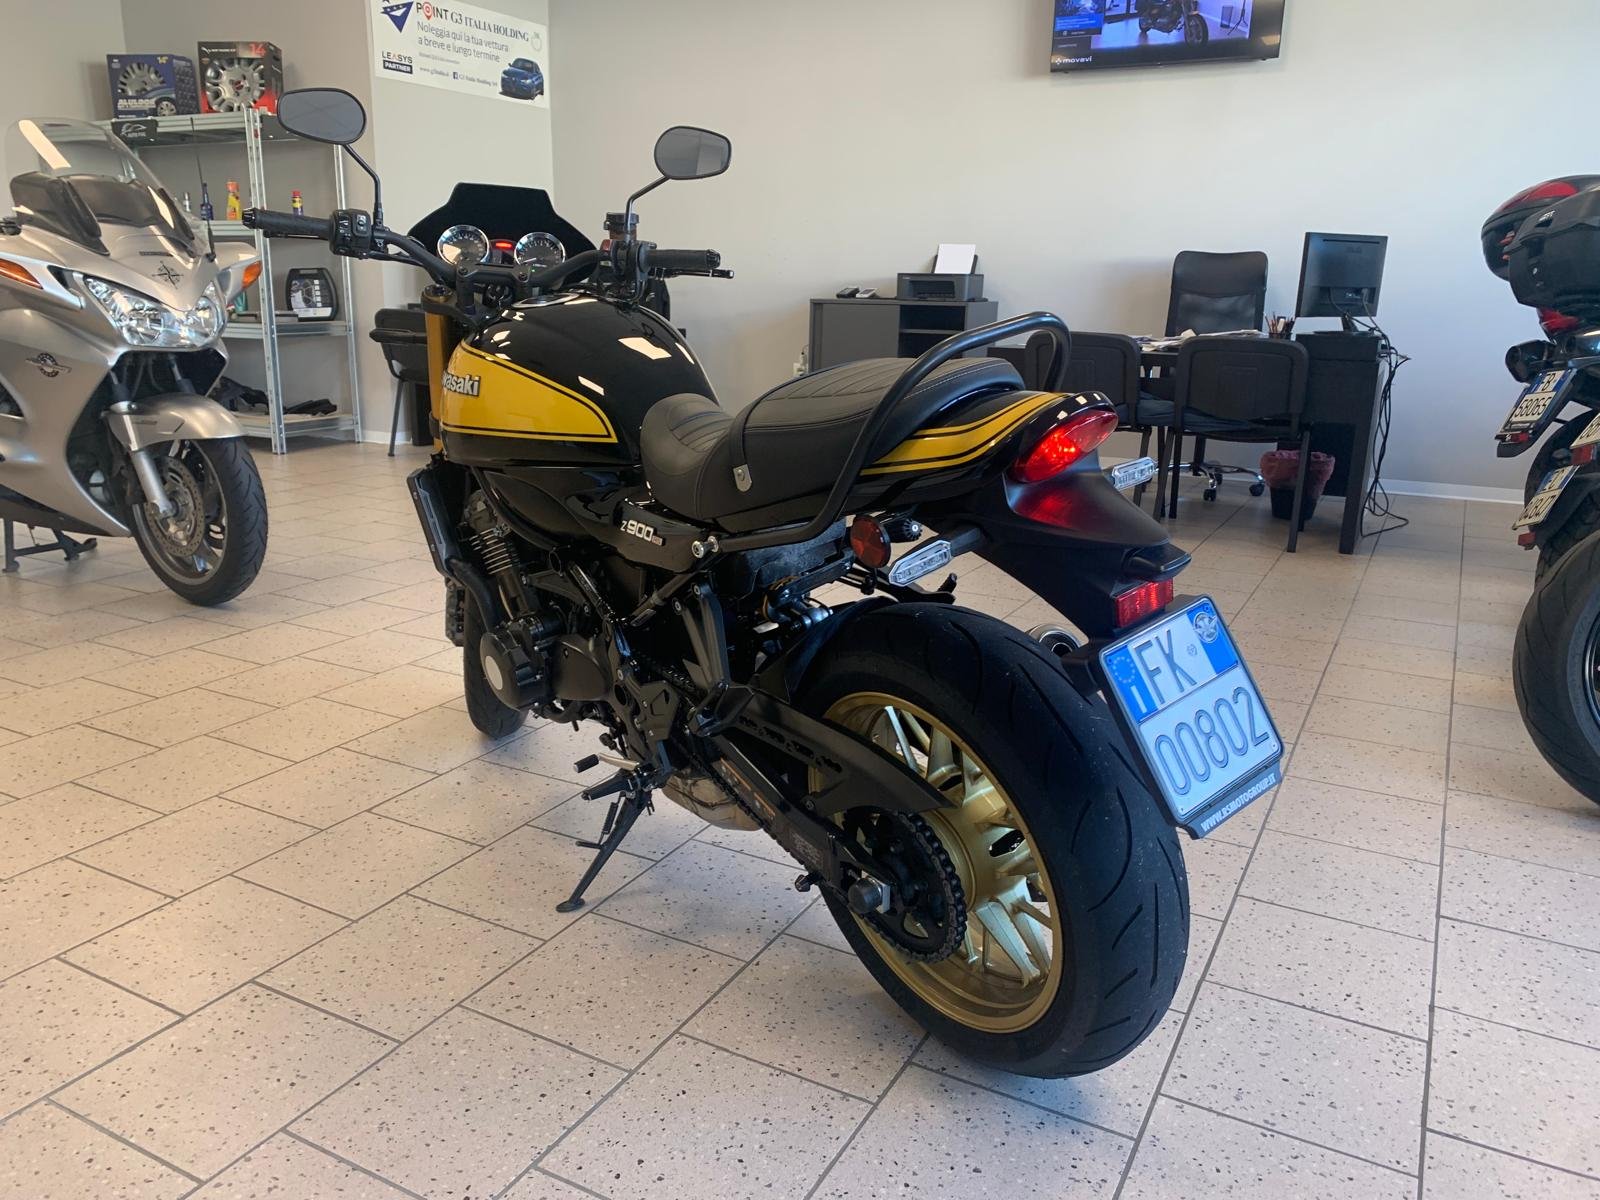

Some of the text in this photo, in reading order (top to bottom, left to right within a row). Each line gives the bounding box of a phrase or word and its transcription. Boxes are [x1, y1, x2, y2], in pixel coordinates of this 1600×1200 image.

[416, 1, 529, 42] POINT G3 ITALIA HOLDING
[417, 21, 509, 52] Noleggia qui la tua vettura
[418, 37, 423, 45] a
[423, 36, 445, 50] breve
[446, 43, 451, 52] e
[452, 43, 472, 58] lungo
[473, 49, 500, 63] termine
[382, 50, 413, 64] LEASYS
[384, 60, 411, 72] PARTNER
[1062, 55, 1093, 64] movavi
[1133, 629, 1197, 705] FK
[1154, 686, 1270, 796] 00802
